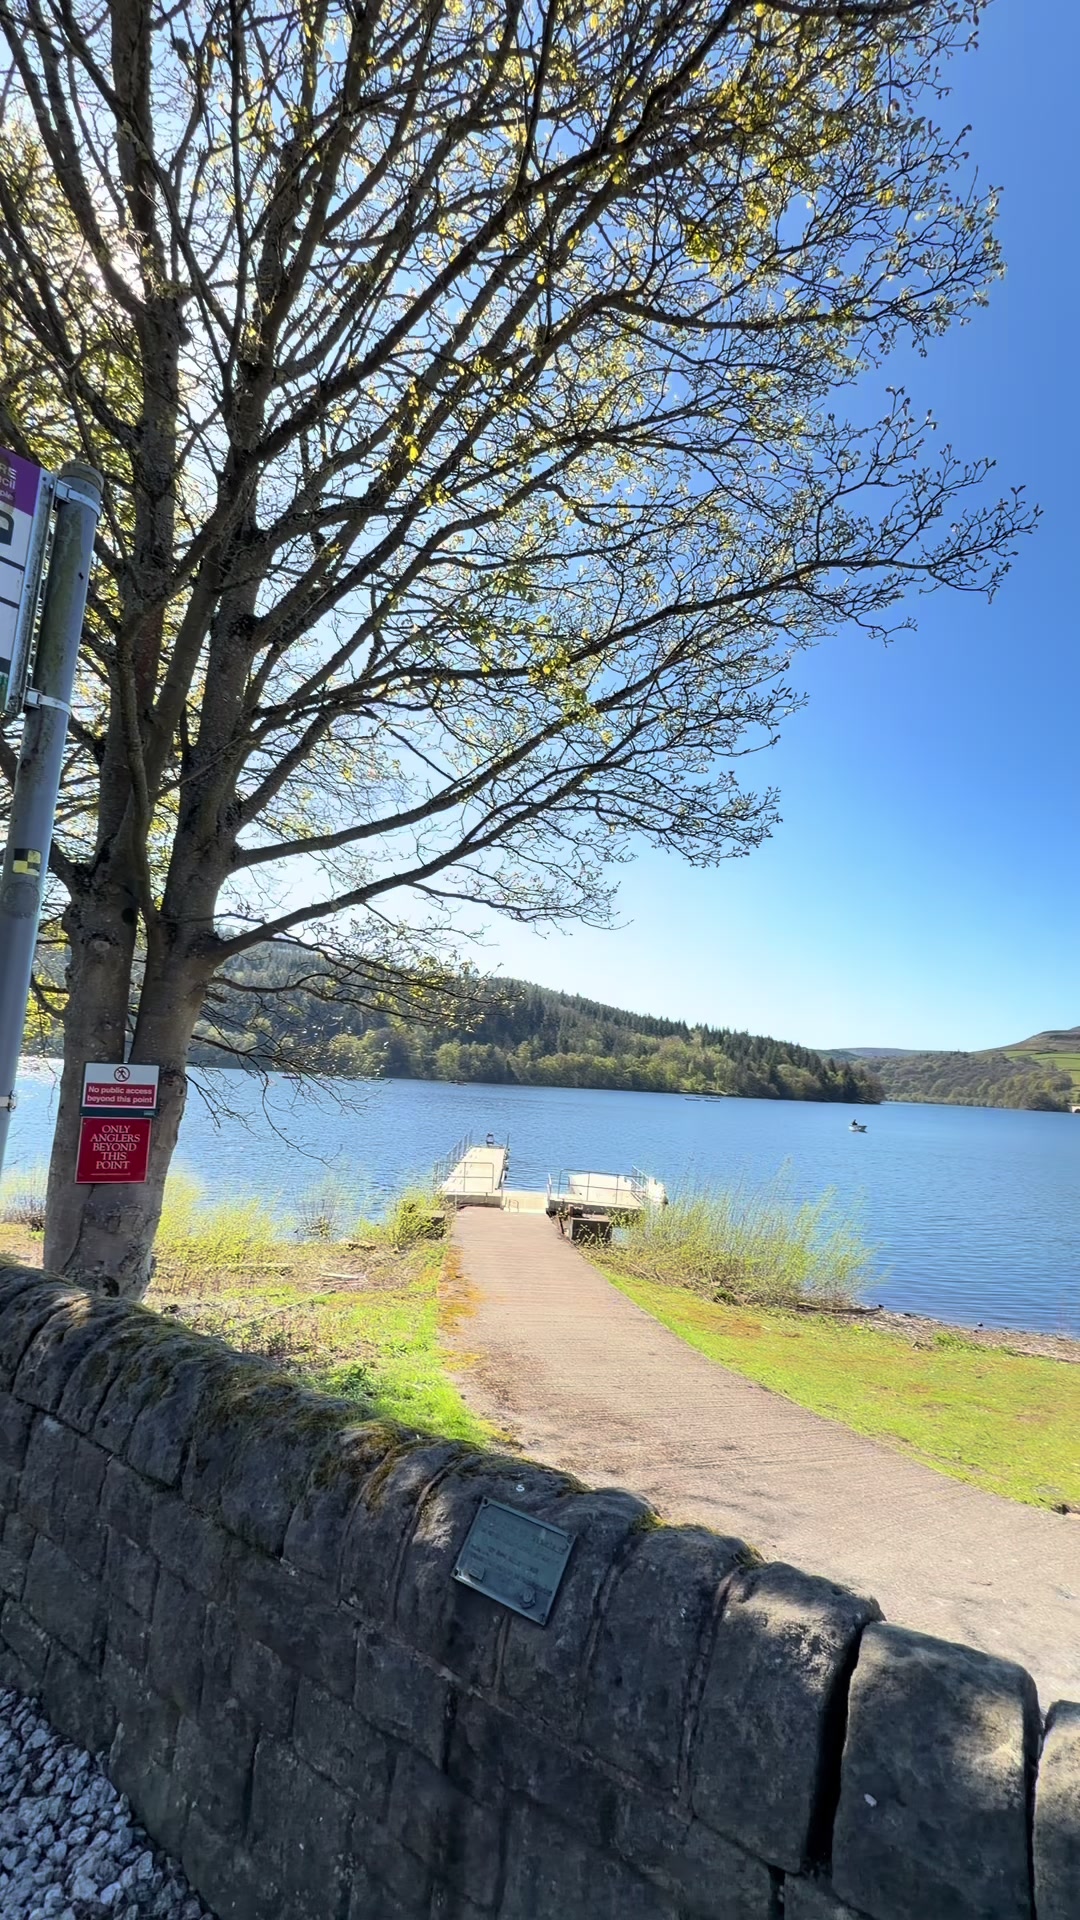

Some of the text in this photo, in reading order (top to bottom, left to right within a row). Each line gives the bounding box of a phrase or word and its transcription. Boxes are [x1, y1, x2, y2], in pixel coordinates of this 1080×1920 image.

[100, 1086, 124, 1094] public
[87, 1095, 152, 1104] beyond this point
[101, 1125, 131, 1133] ONLY
[90, 1134, 141, 1142] ANGLERS
[92, 1143, 137, 1151] BEYOND
[101, 1152, 127, 1160] THIS
[96, 1161, 131, 1169] POINT
